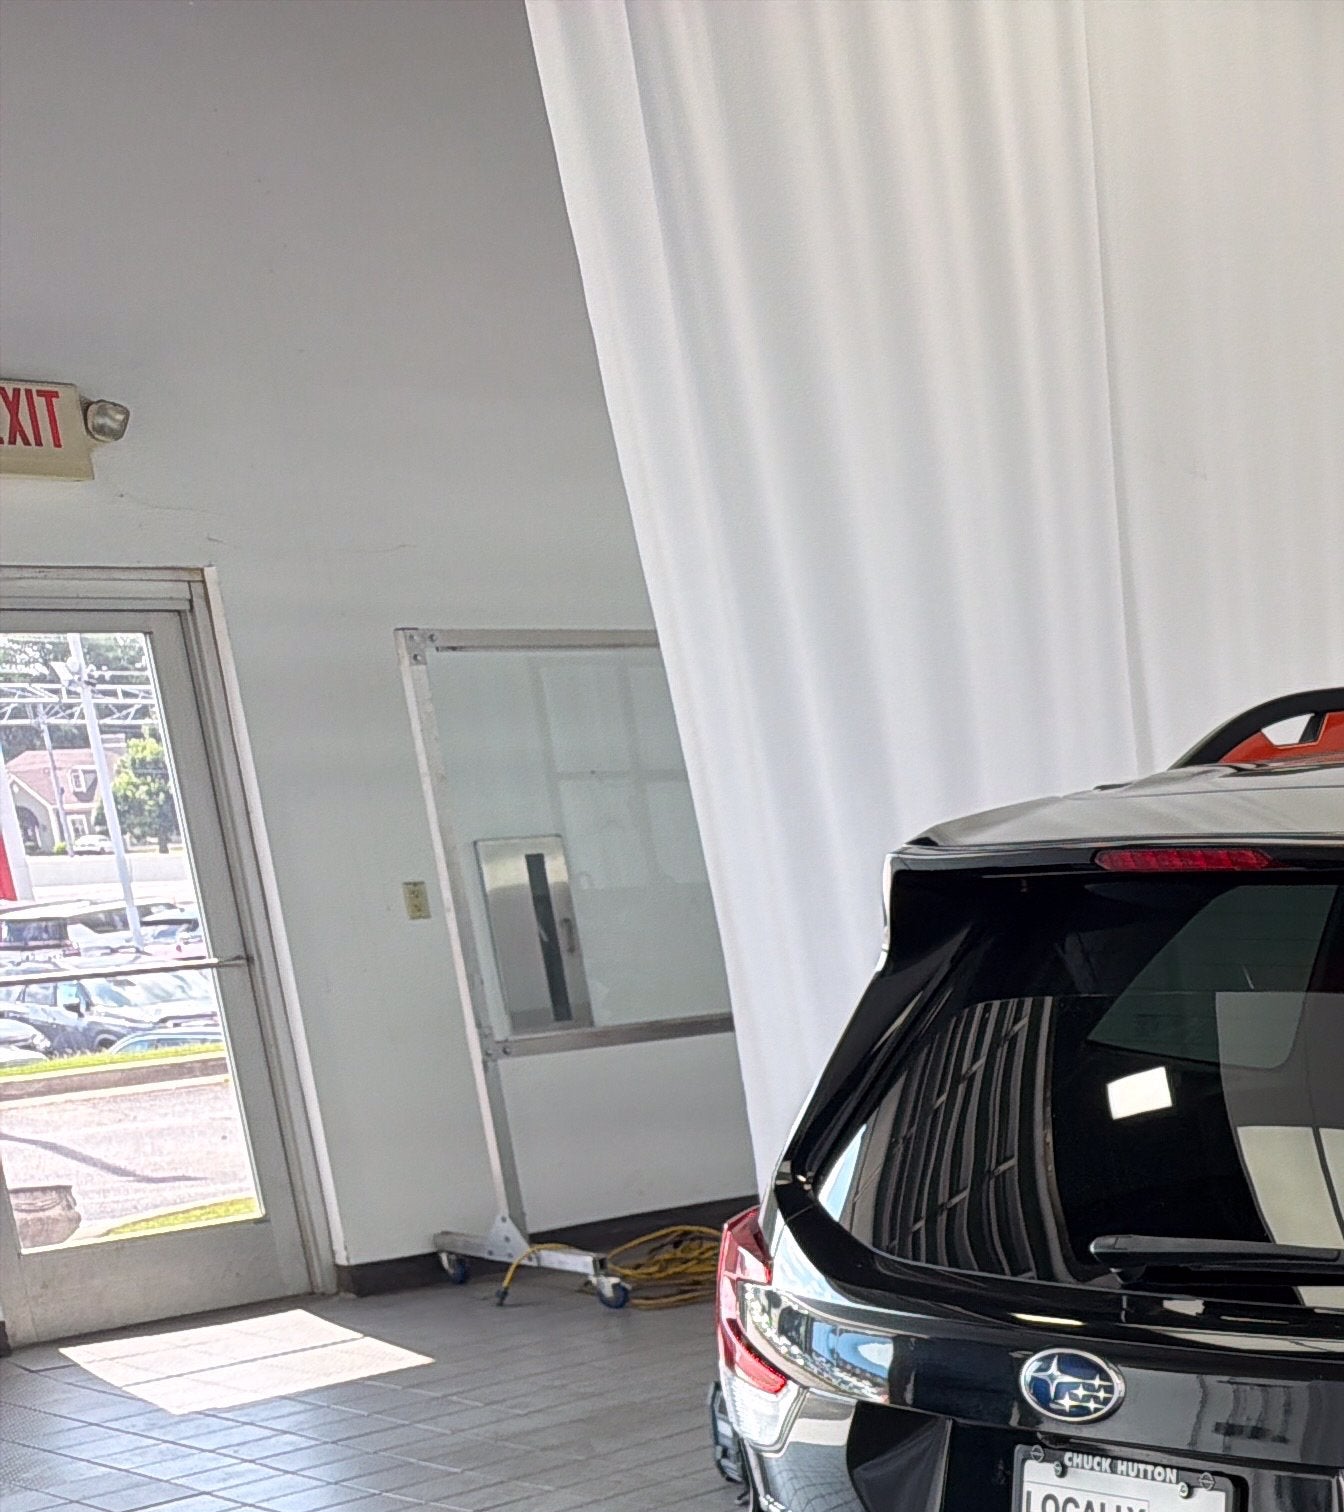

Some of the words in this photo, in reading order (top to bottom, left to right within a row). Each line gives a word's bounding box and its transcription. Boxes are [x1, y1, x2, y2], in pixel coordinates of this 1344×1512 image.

[0, 386, 62, 448] XIT
[1064, 1452, 1112, 1474] CHUCK
[1117, 1460, 1178, 1484] HUTTON
